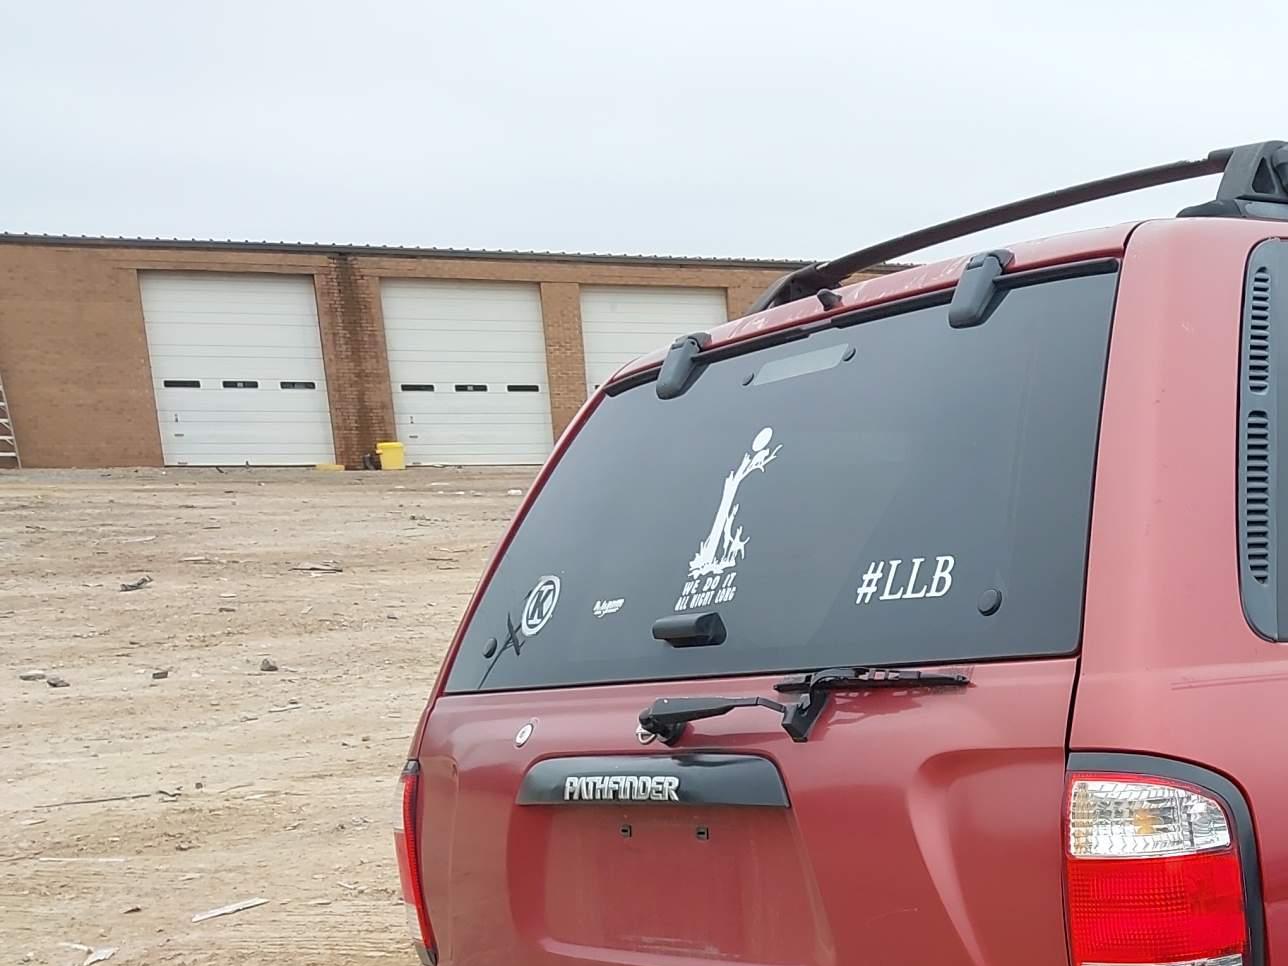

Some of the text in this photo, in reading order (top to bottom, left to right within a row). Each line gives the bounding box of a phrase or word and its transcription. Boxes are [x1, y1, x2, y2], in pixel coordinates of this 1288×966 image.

[682, 572, 737, 596] WE DO IT
[856, 555, 955, 604] #LLB
[563, 775, 680, 801] PATHFINDER
